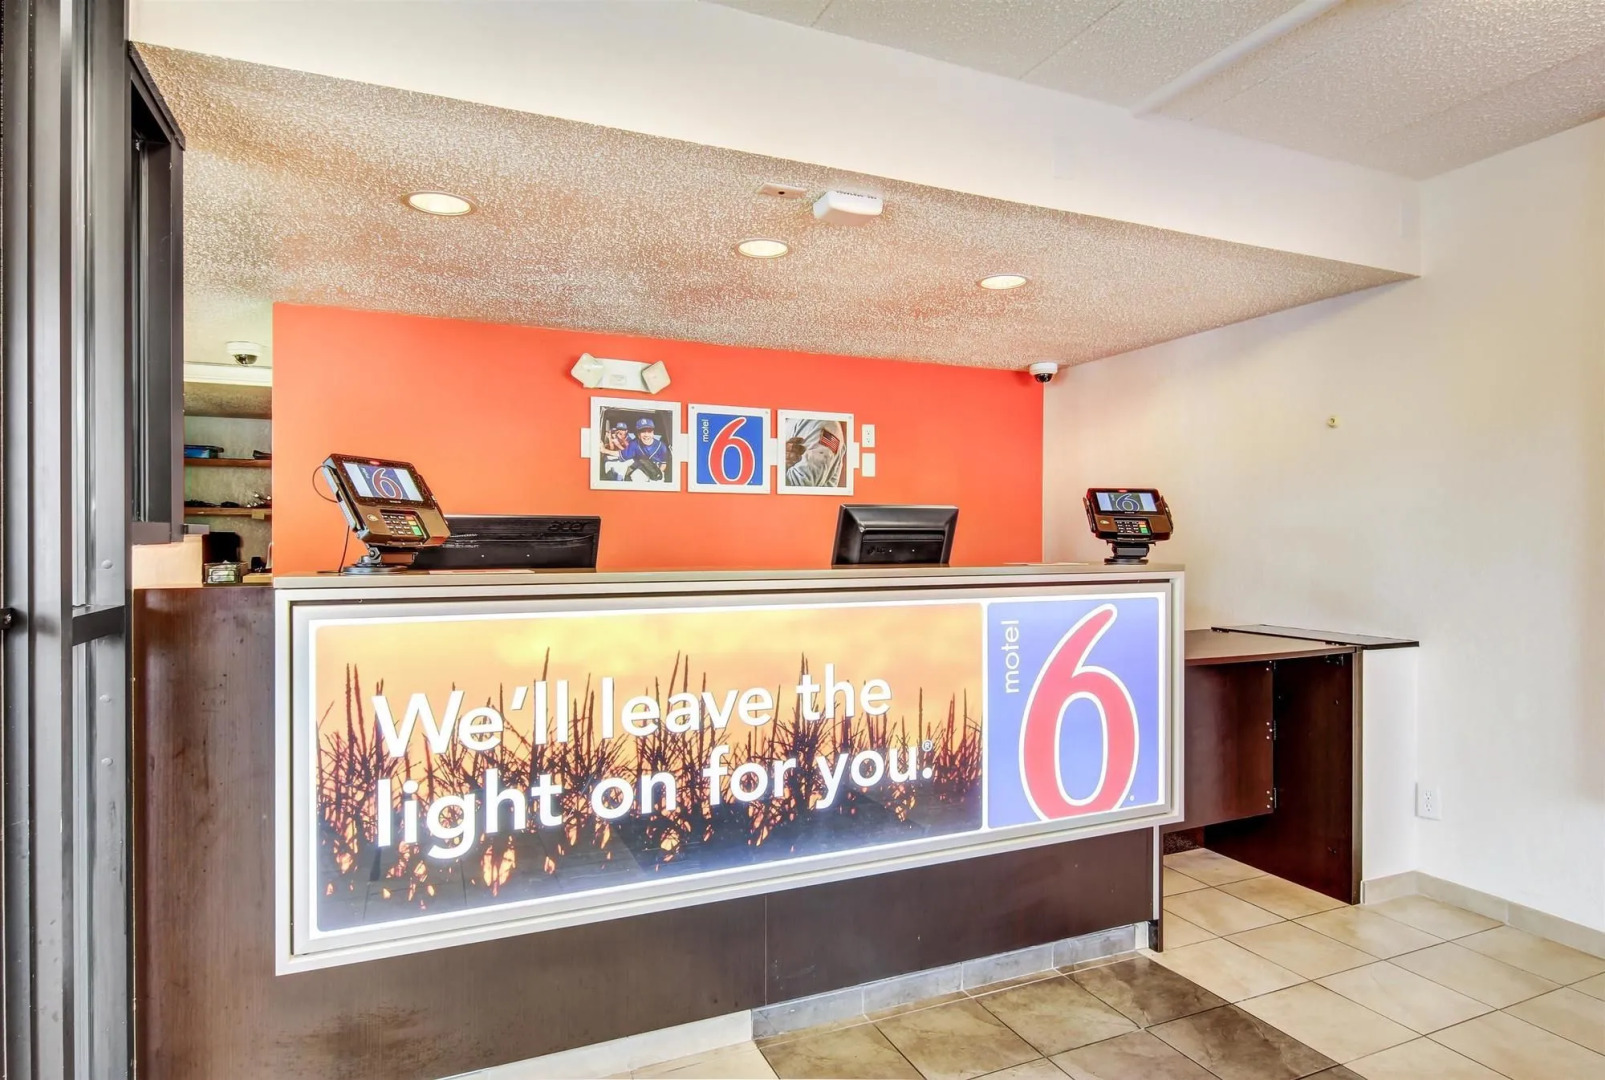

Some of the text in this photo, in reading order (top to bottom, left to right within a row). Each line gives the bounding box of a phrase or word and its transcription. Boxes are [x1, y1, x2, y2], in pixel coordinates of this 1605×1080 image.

[372, 467, 403, 499] 6
[708, 416, 755, 485] 6
[549, 520, 592, 532] acer
[1115, 493, 1140, 511] 6
[1001, 620, 1020, 693] motel
[371, 663, 892, 758] We'll leave the
[1018, 603, 1140, 821] 6
[377, 768, 563, 860] light
[591, 770, 677, 820] on
[702, 745, 796, 806] for
